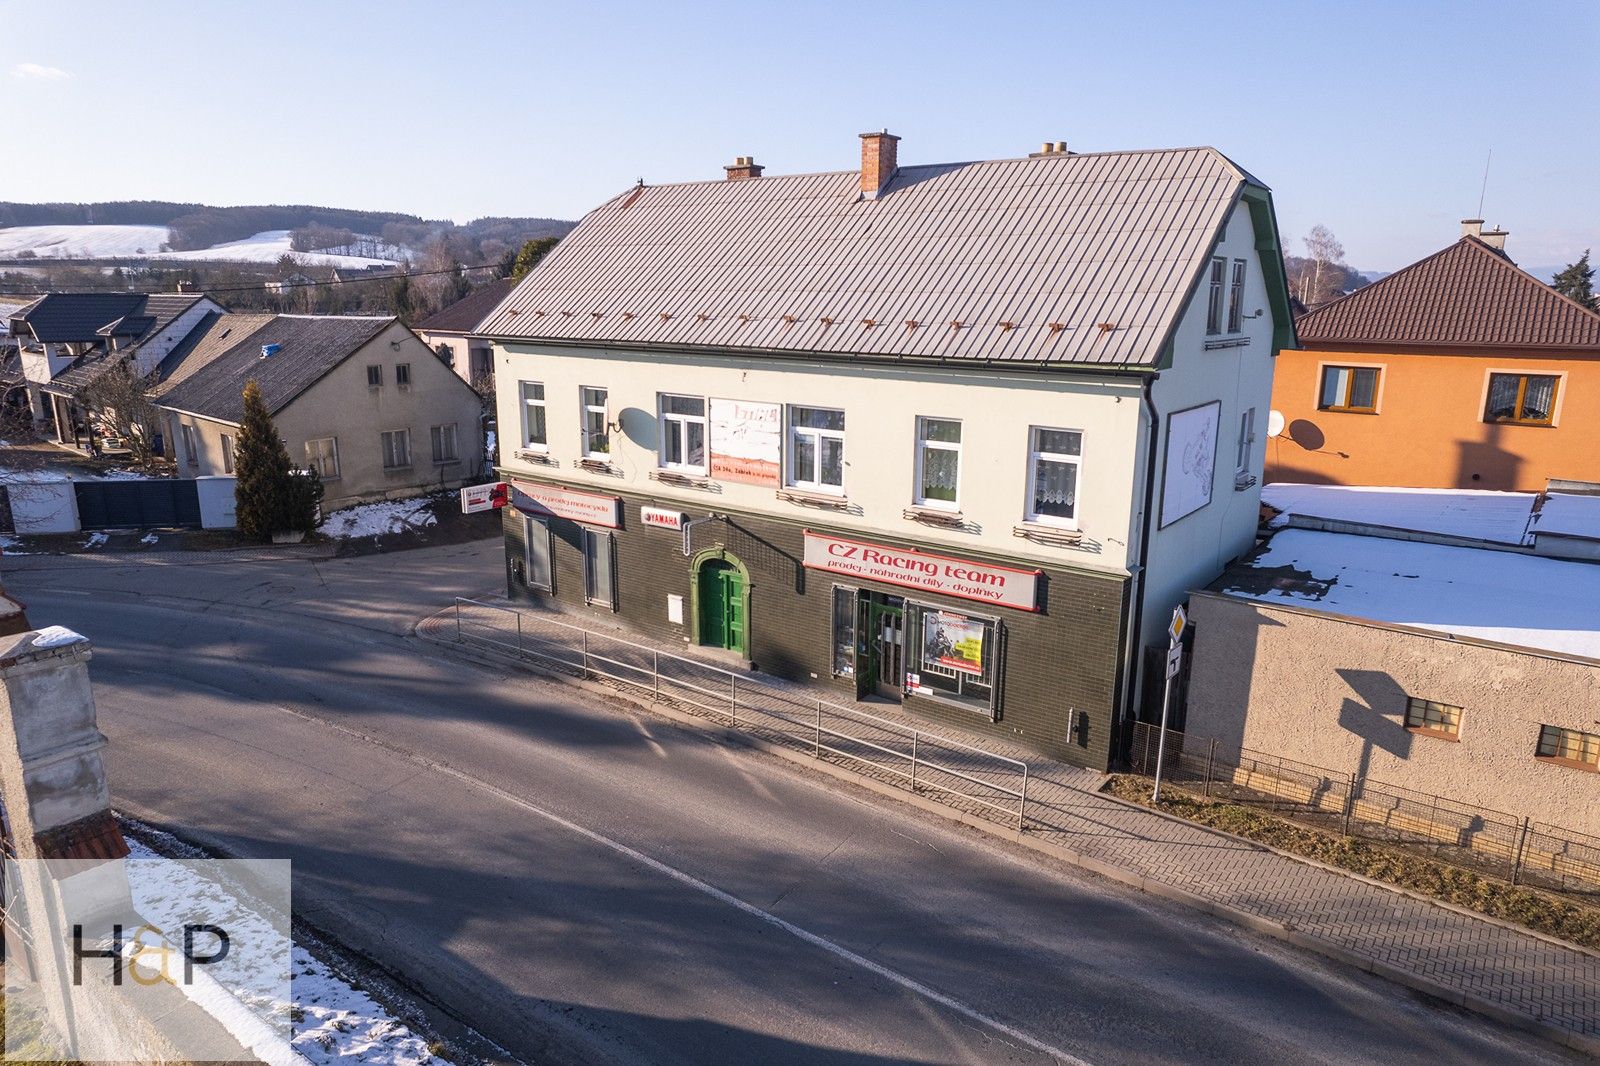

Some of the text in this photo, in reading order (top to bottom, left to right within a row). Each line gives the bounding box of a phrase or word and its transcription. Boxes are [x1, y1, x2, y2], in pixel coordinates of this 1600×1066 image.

[650, 514, 678, 526] YAMAHA
[827, 560, 862, 573] prodej
[828, 543, 1006, 587] CZ Racing team
